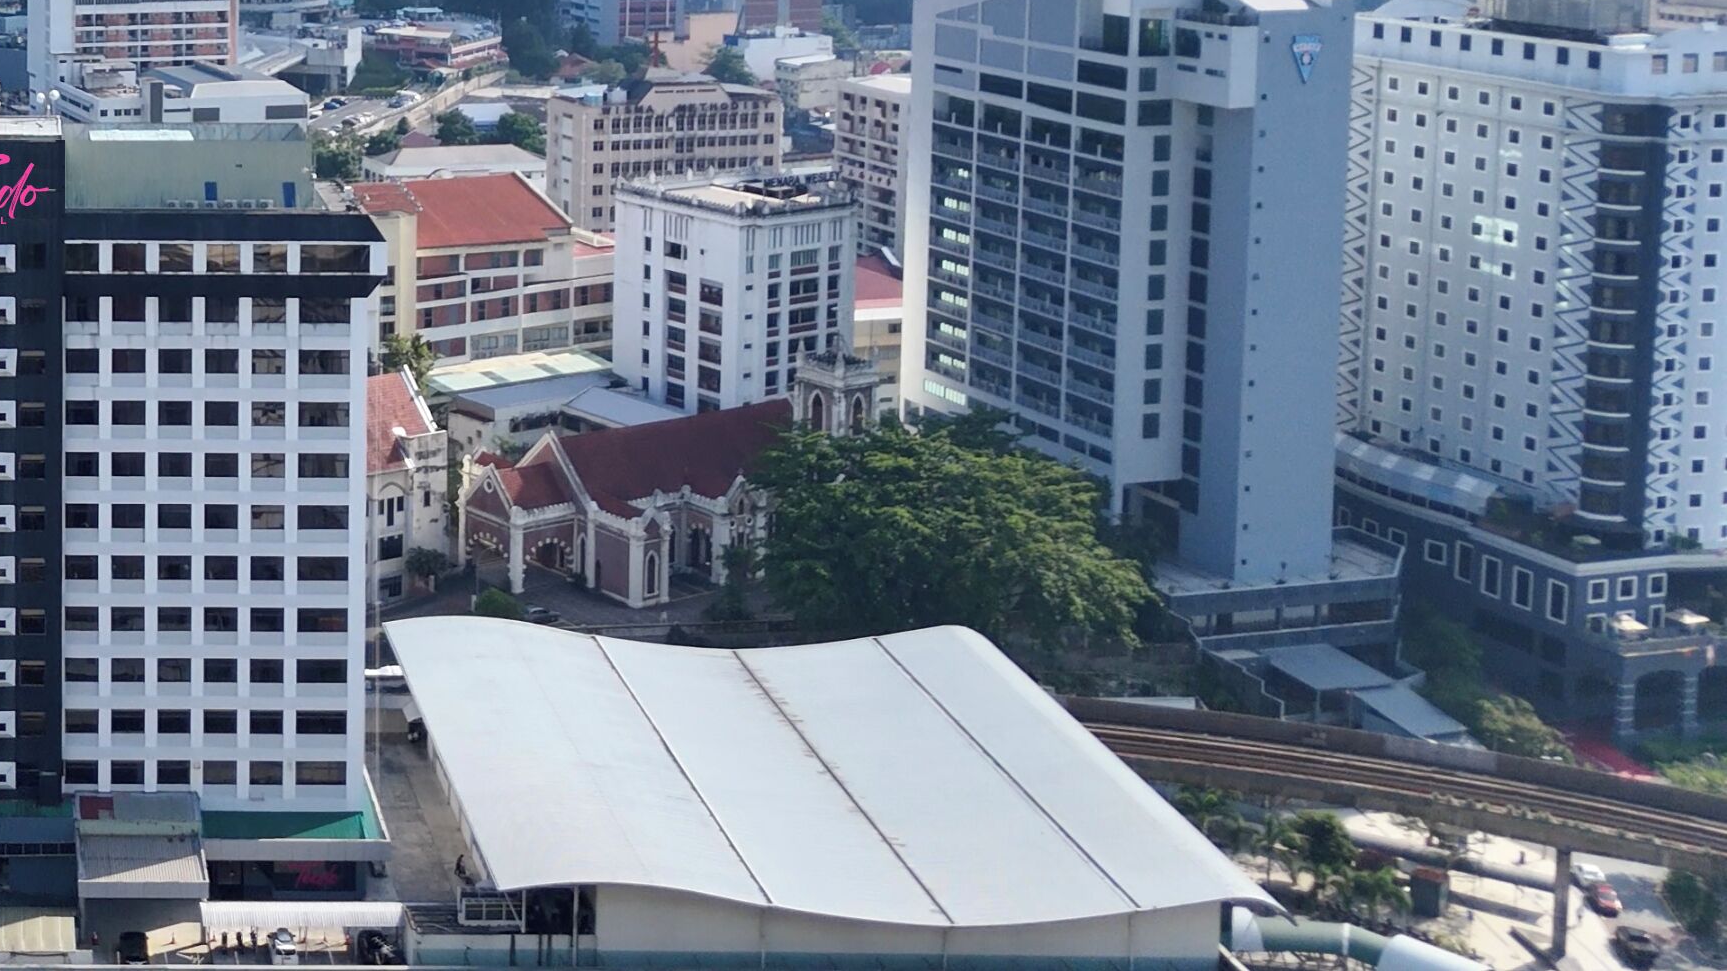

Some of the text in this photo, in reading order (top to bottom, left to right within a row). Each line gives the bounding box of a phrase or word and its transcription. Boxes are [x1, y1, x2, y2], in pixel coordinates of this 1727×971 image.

[601, 101, 770, 115] WISMA METHODIST
[763, 175, 800, 187] MENARA
[805, 172, 840, 183] WESLEY
